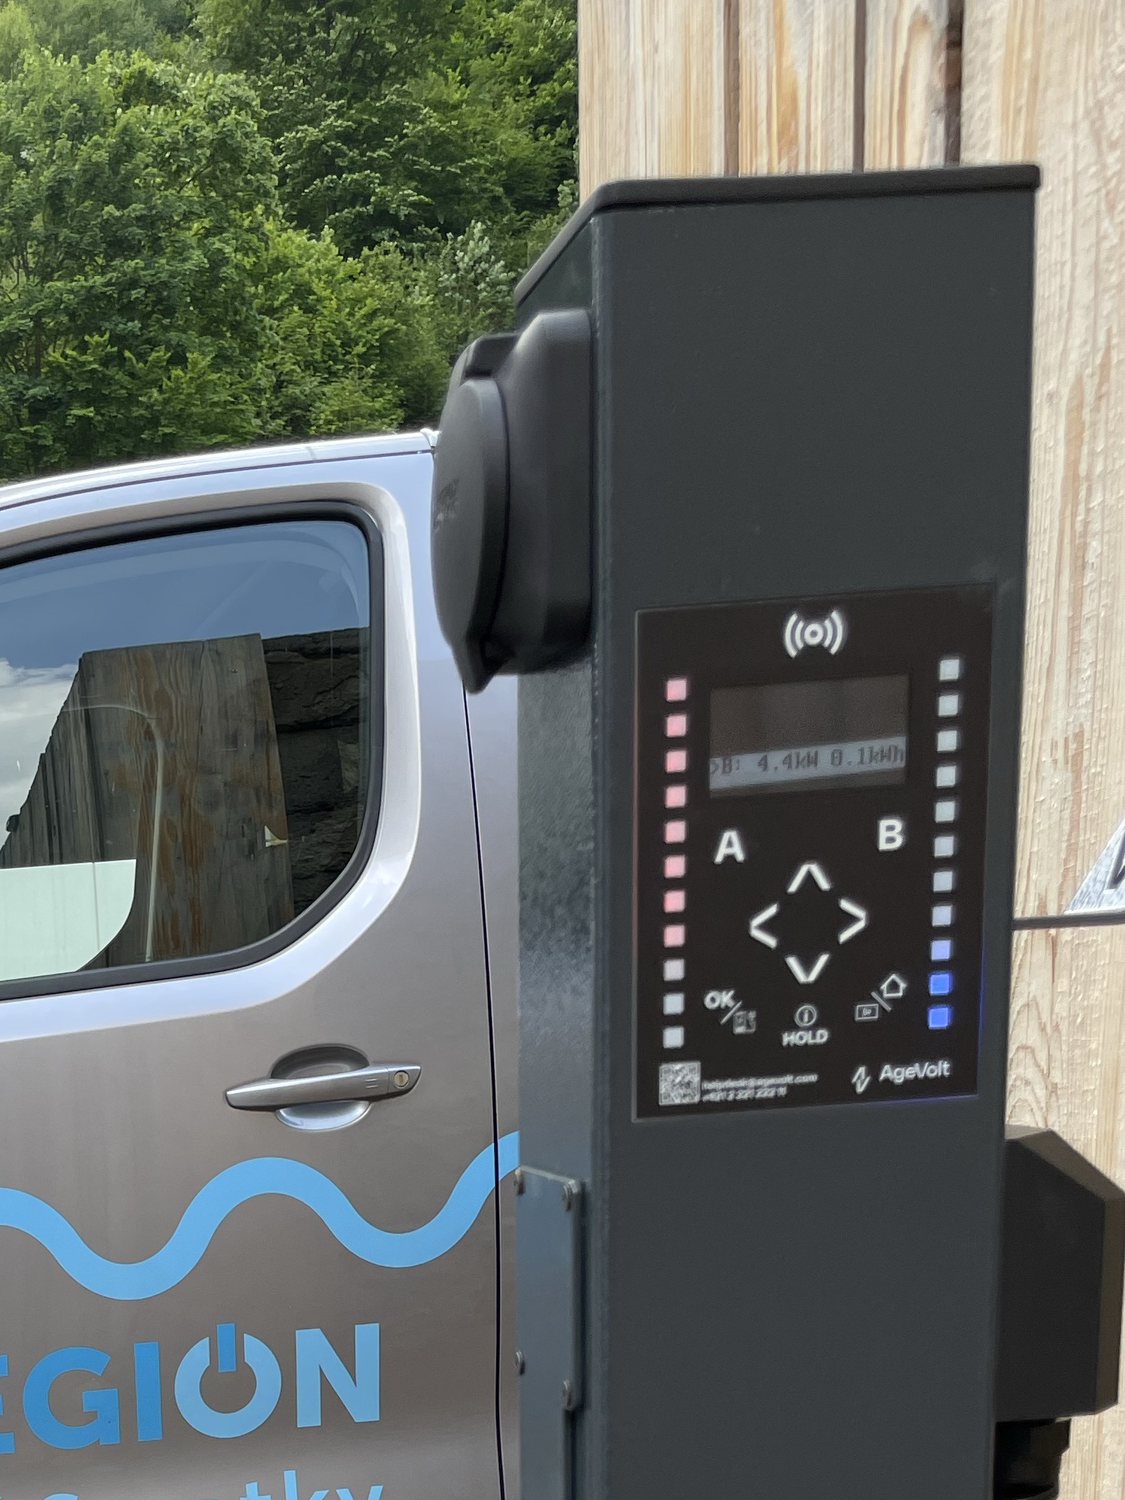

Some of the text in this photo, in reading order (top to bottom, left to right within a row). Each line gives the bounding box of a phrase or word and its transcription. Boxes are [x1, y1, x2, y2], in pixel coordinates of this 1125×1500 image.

[757, 748, 818, 773] 4.4kW
[713, 829, 746, 865] A
[878, 817, 905, 852] B
[704, 989, 735, 1010] OK
[781, 1028, 829, 1047] HOLD
[878, 1060, 951, 1085] AgeVolt
